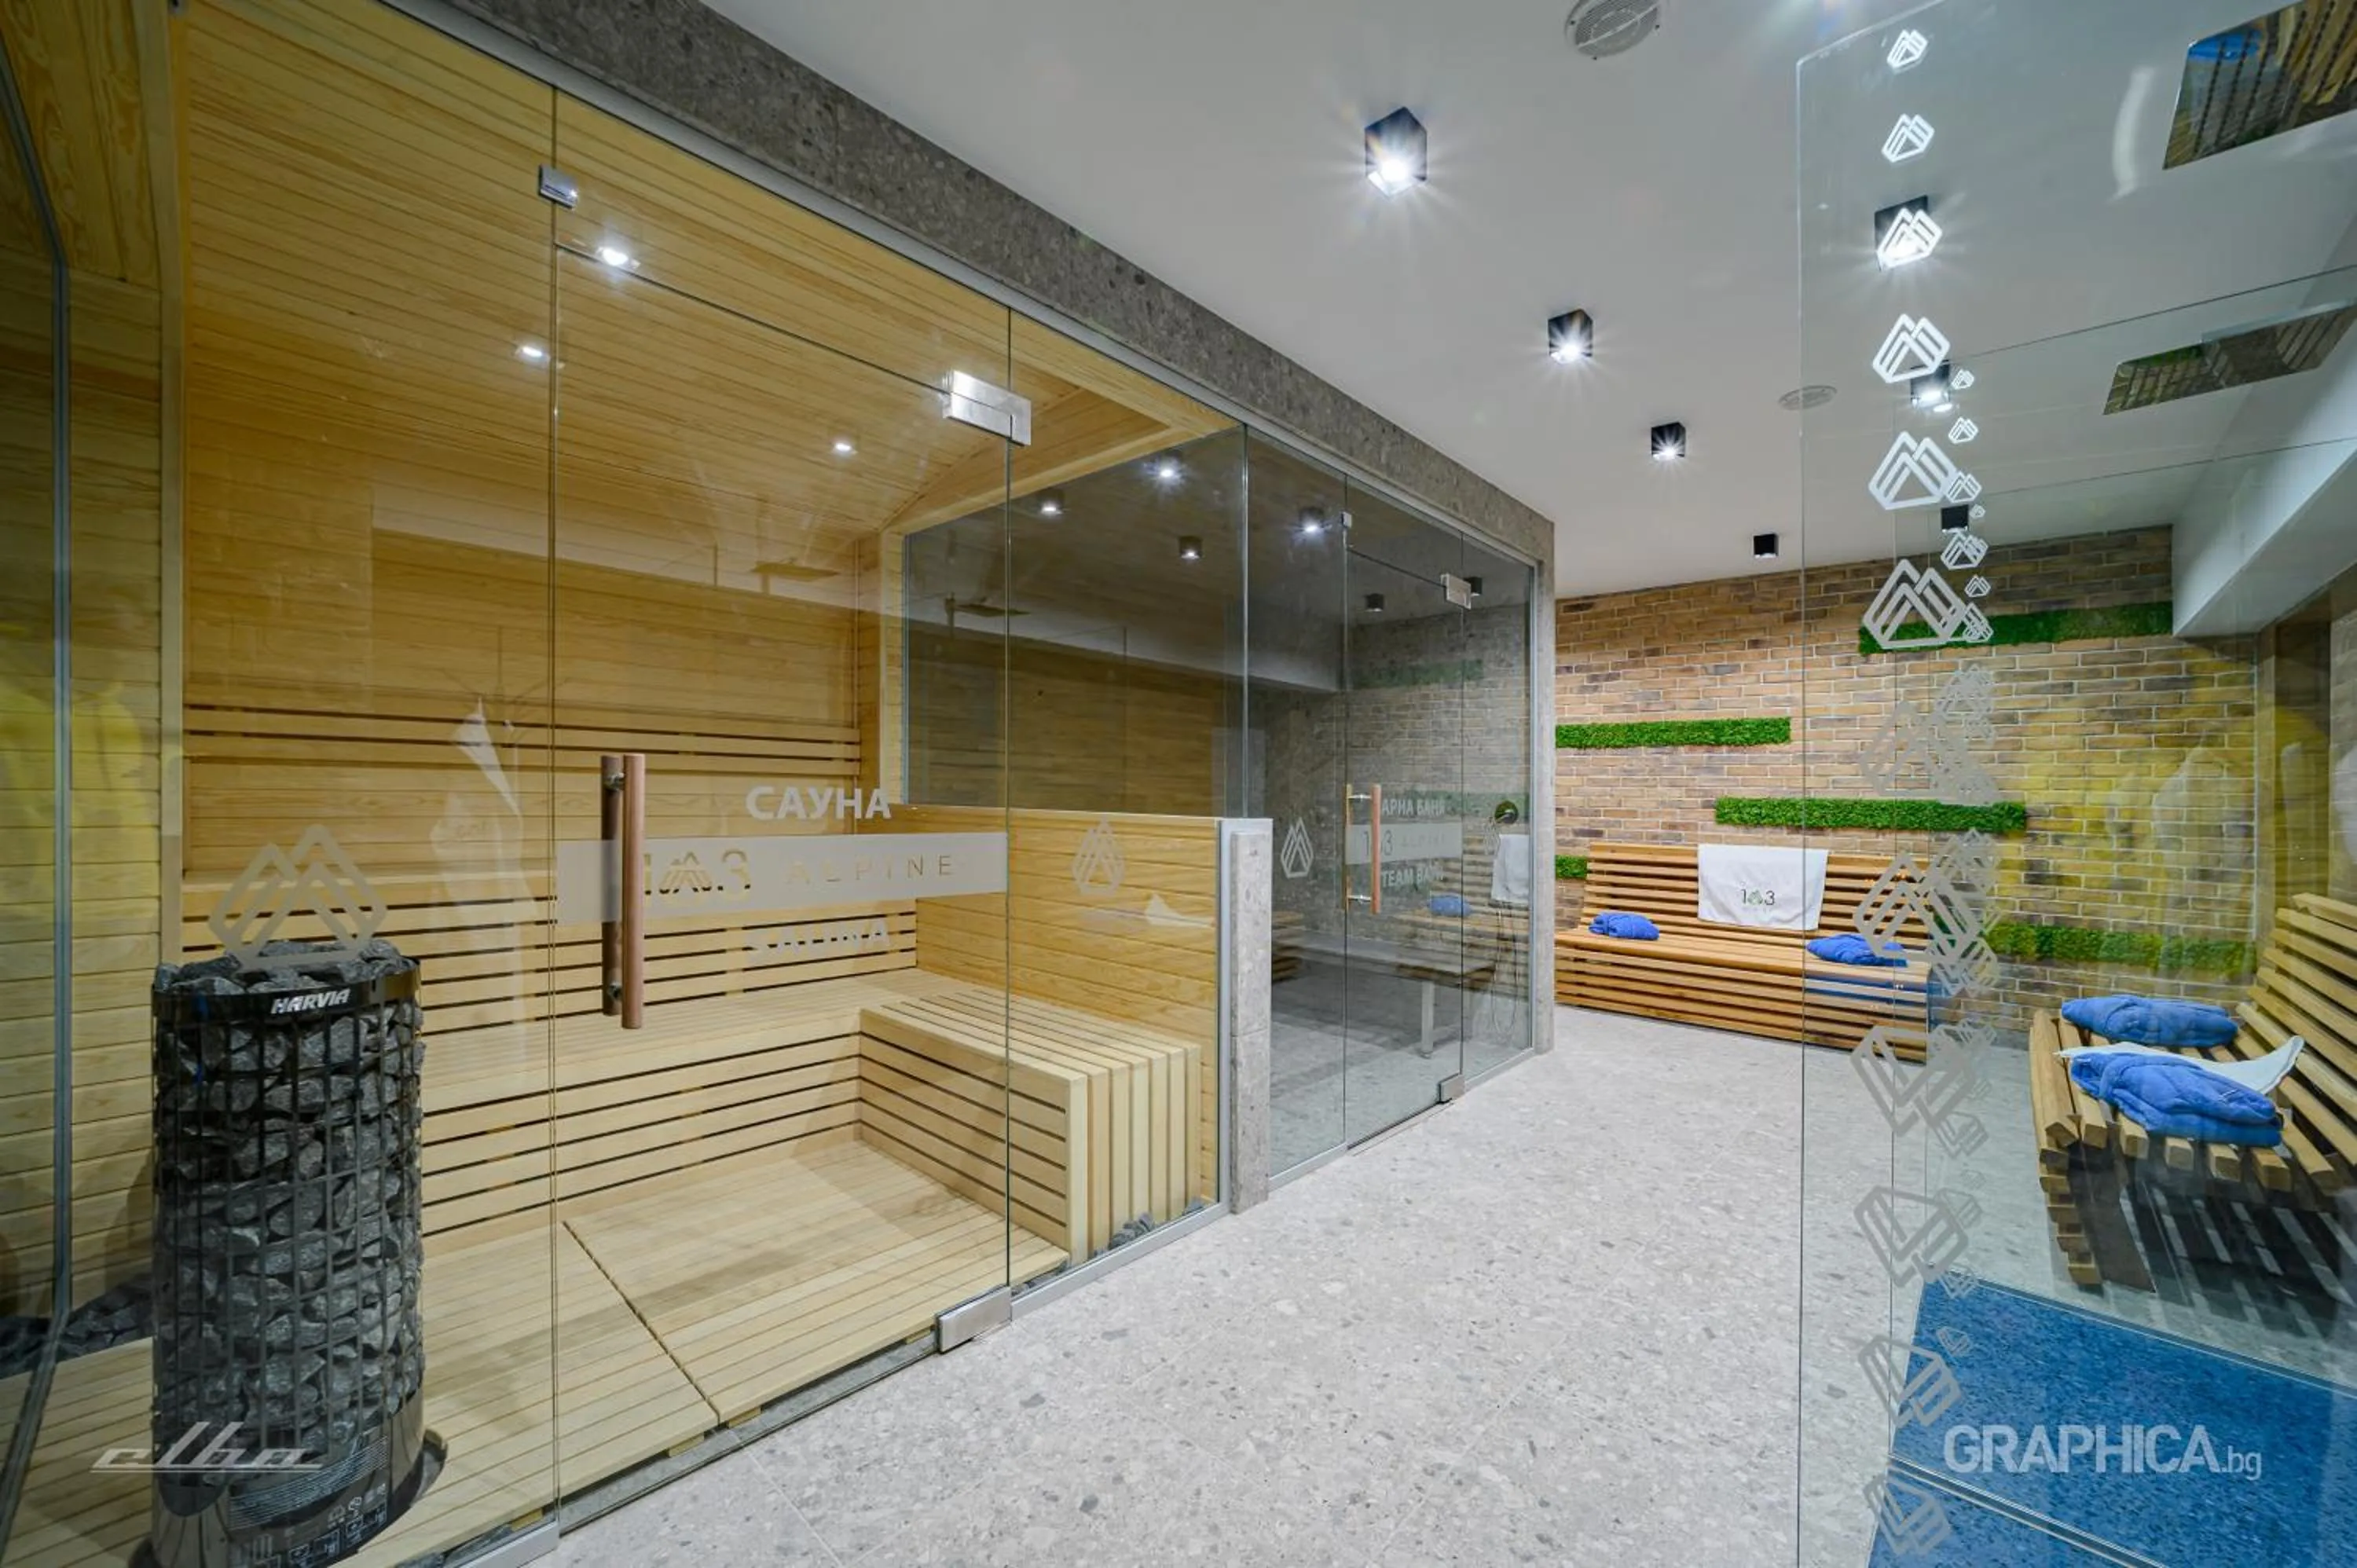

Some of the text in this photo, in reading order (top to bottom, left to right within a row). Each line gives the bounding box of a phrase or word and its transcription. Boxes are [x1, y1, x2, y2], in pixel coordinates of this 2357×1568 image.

[745, 786, 892, 820] САУНА
[1382, 798, 1413, 816] АРНА
[786, 853, 955, 885] ALPINE
[1382, 867, 1414, 888] TEAM
[270, 988, 350, 1014] HARVIA
